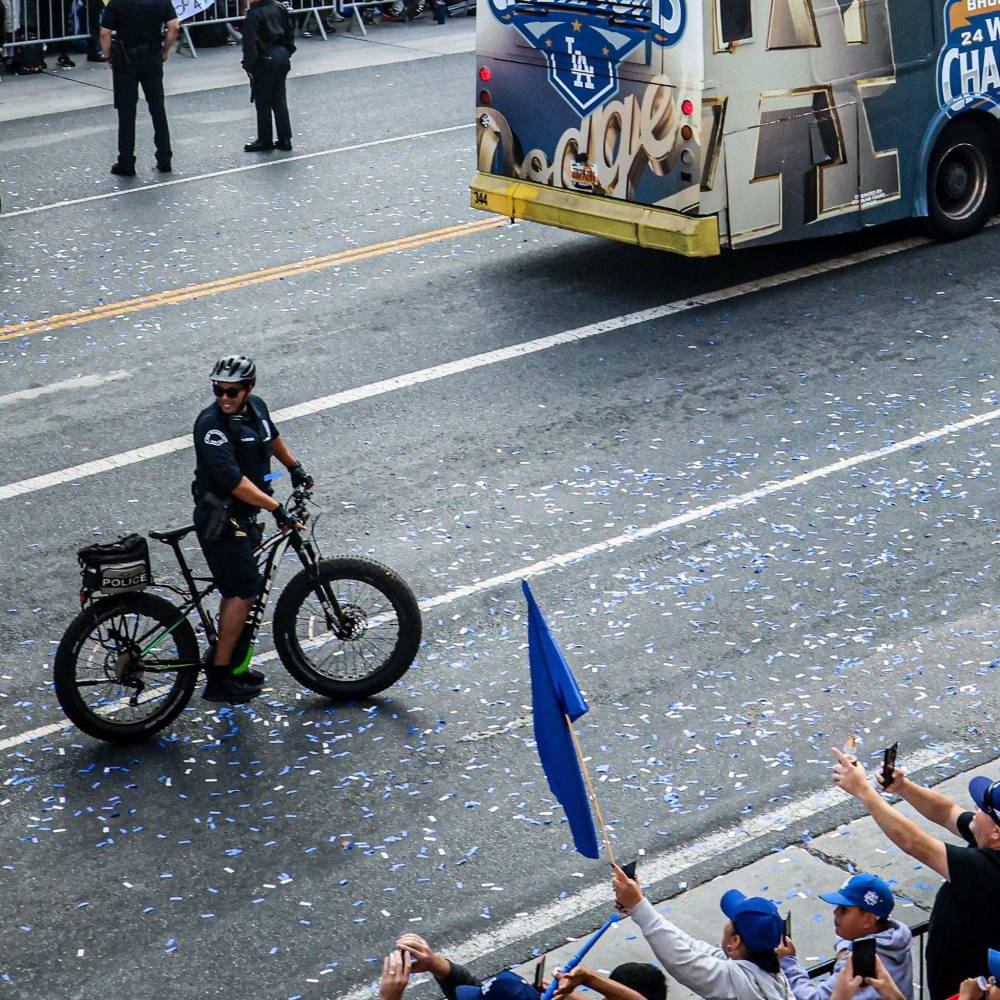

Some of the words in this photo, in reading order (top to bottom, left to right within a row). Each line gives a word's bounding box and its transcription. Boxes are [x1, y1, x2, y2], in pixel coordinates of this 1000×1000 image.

[961, 29, 984, 47] 24
[564, 36, 595, 89] LA
[473, 191, 488, 205] 344
[102, 573, 148, 588] POLICE
